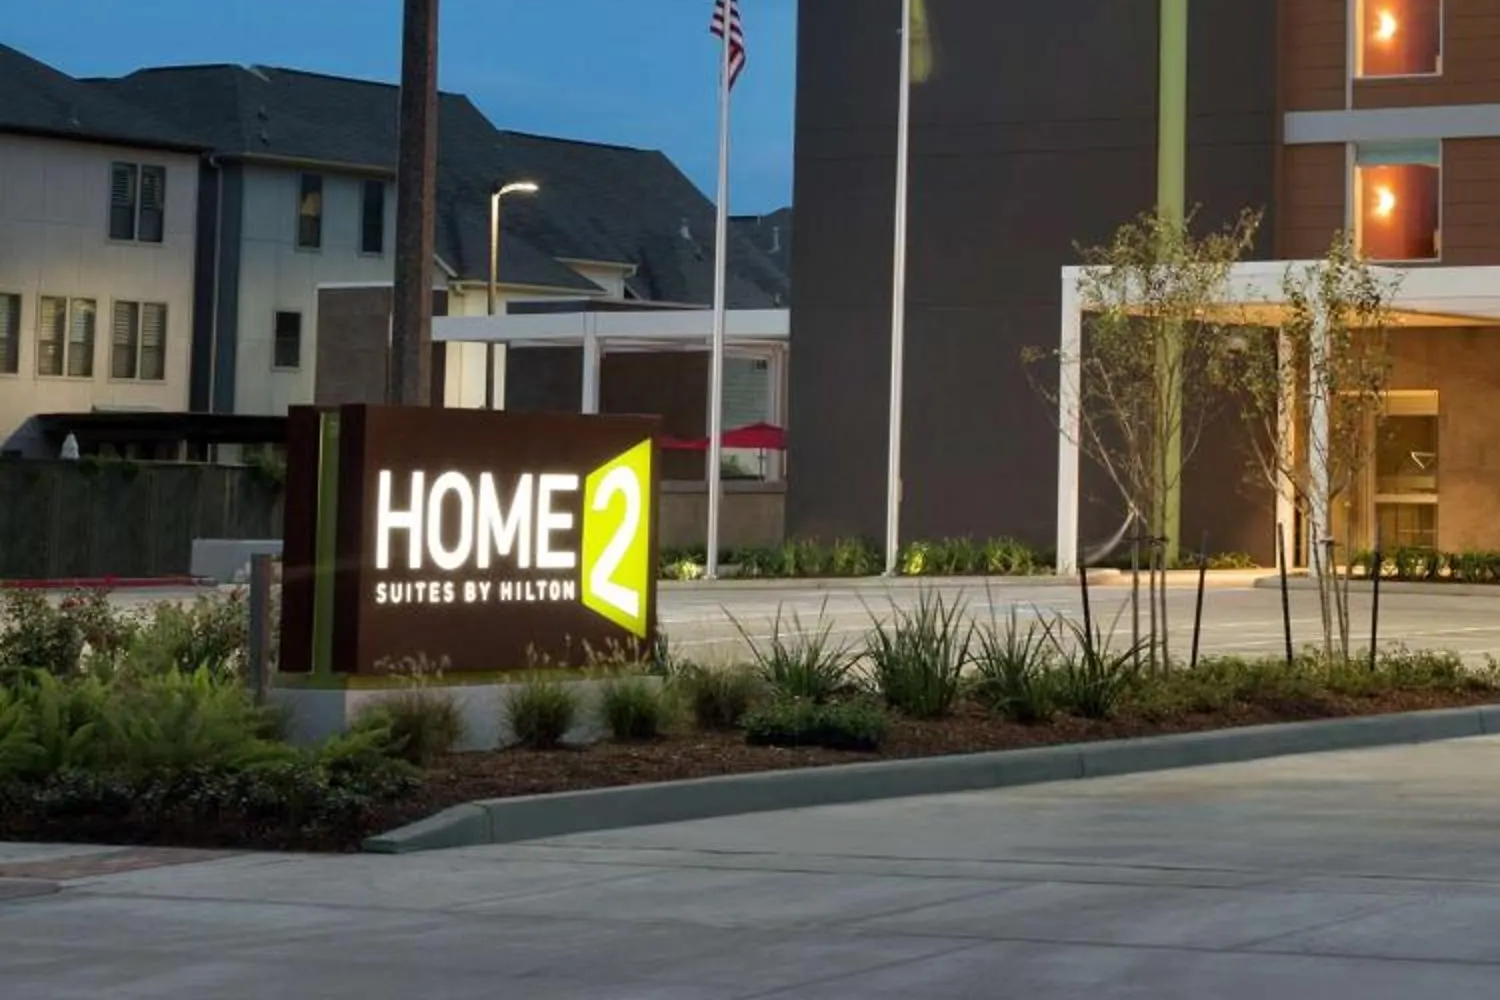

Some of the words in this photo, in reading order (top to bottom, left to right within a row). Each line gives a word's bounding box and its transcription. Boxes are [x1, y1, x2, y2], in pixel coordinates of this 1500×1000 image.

[376, 581, 455, 604] SUITES
[464, 581, 491, 603] BY
[500, 579, 575, 601] HILTON
